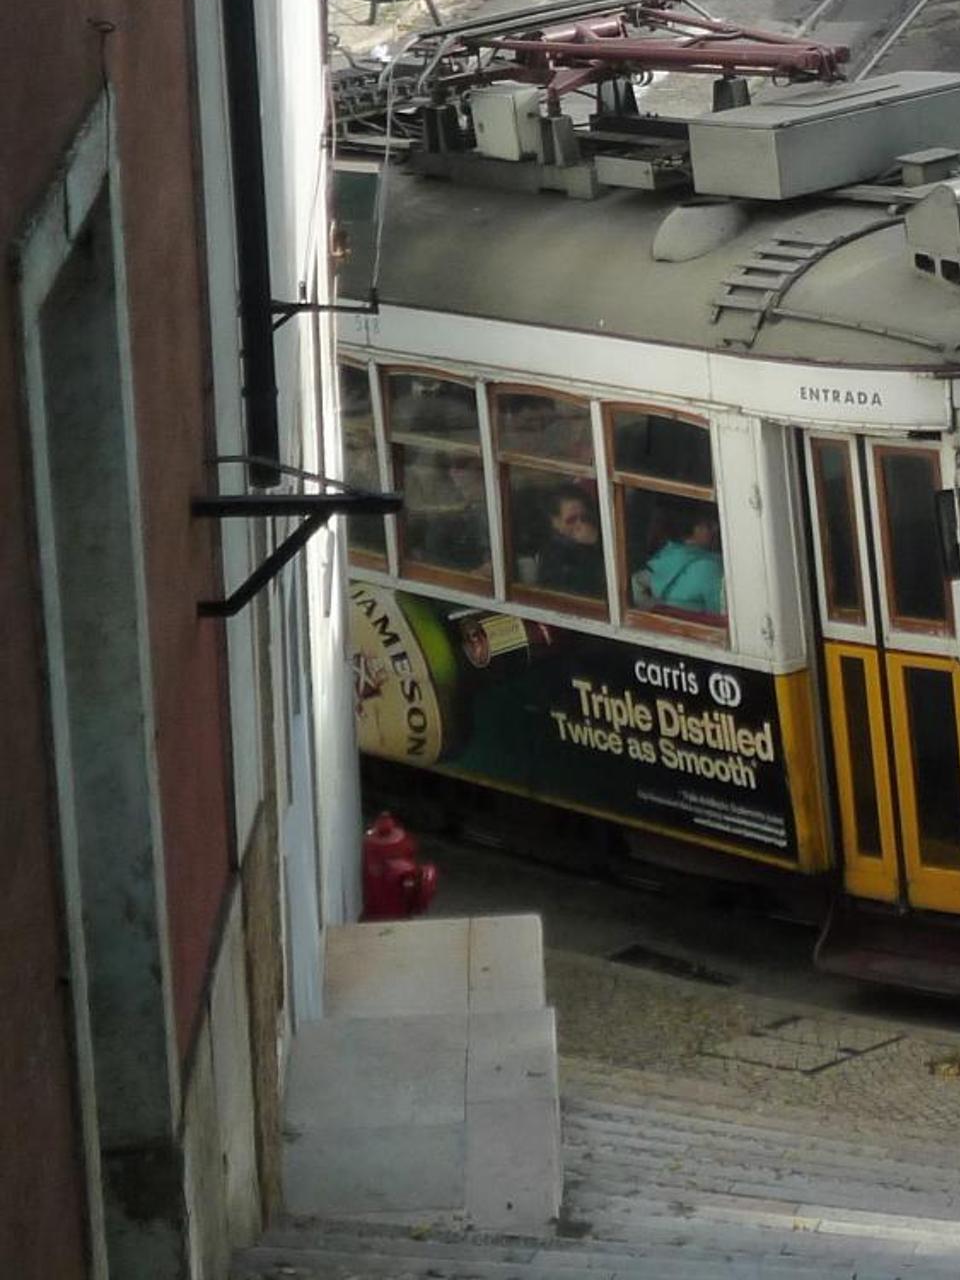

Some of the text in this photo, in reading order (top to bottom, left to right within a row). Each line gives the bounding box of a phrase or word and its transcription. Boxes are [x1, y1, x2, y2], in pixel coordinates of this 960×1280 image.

[799, 386, 883, 406] ENTRADA
[634, 660, 699, 695] carris
[550, 710, 623, 755] Twice
[627, 738, 657, 764] as
[571, 678, 775, 763] Triple Distilled
